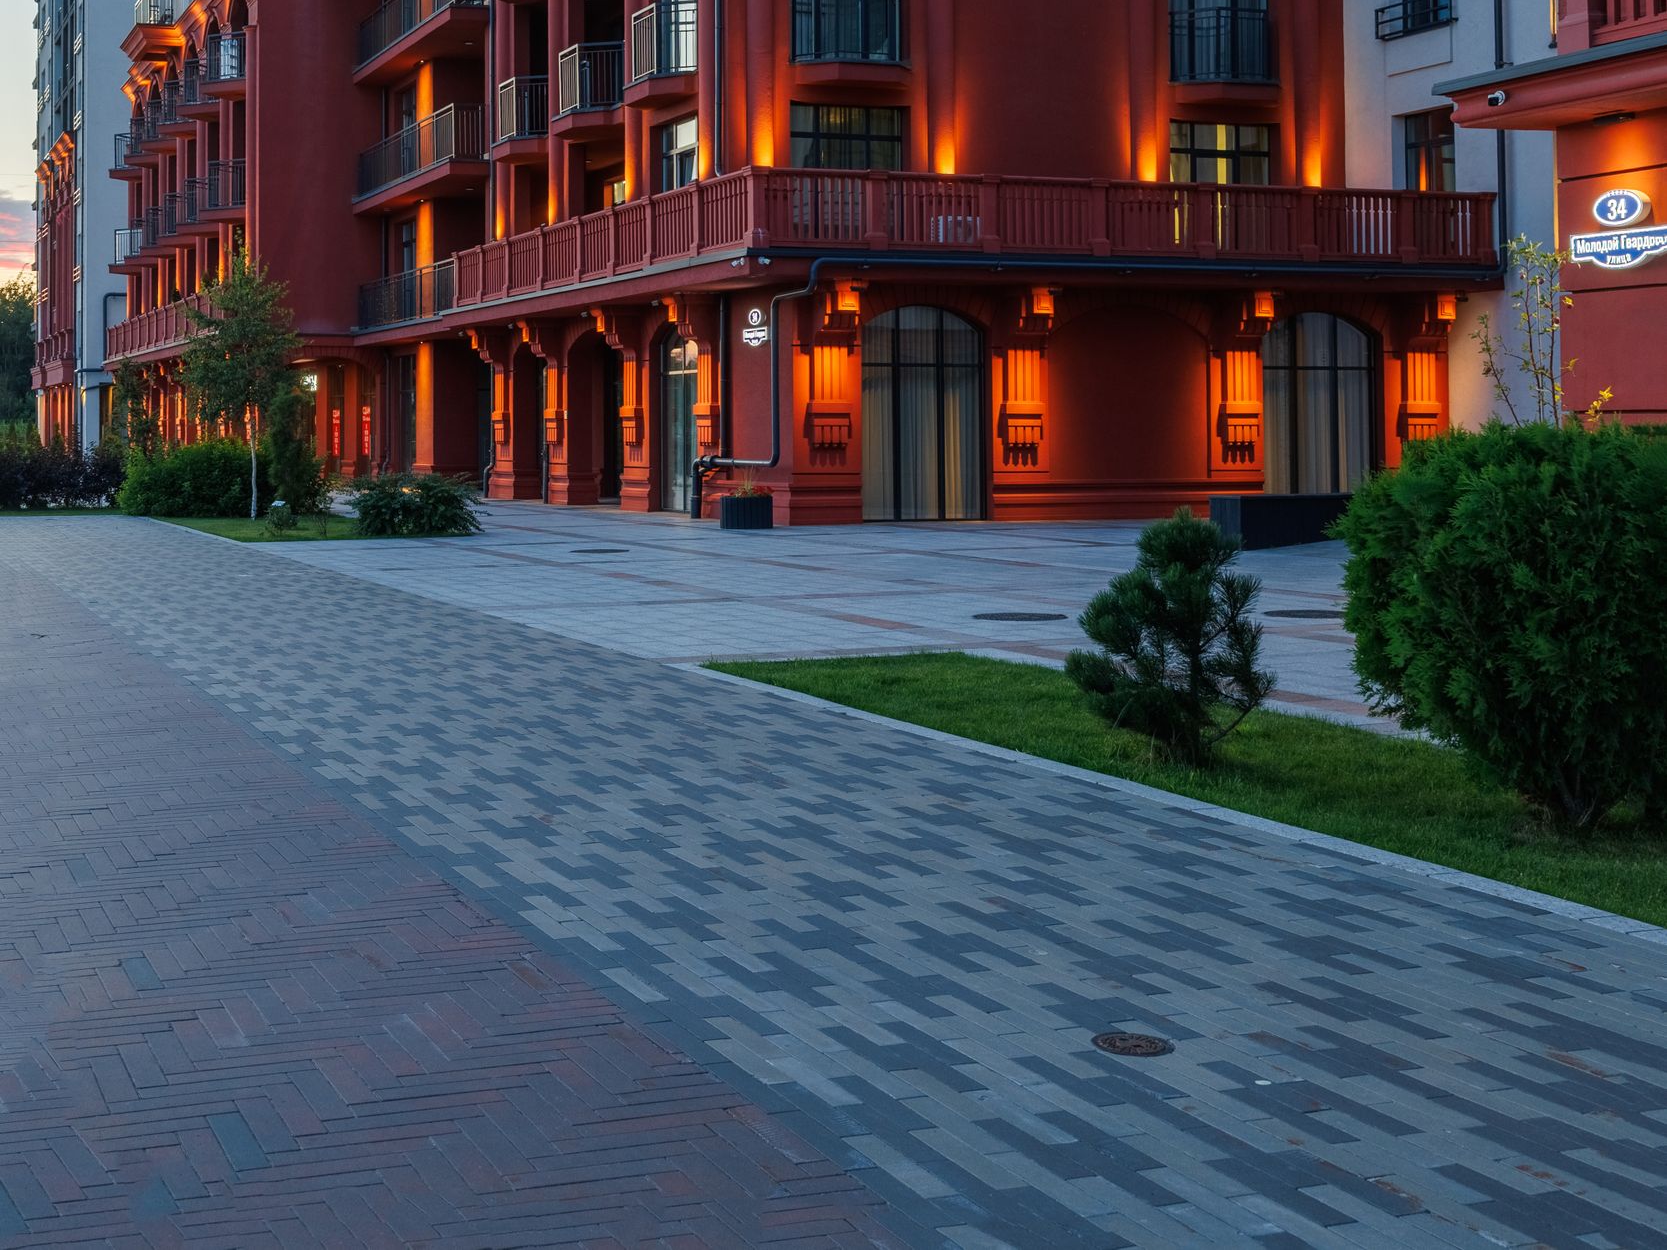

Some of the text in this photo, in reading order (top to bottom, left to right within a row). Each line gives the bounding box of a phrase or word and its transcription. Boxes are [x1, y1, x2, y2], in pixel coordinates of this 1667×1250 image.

[1607, 198, 1628, 220] 34
[1576, 236, 1619, 254] Молодой
[1606, 253, 1632, 265] улица
